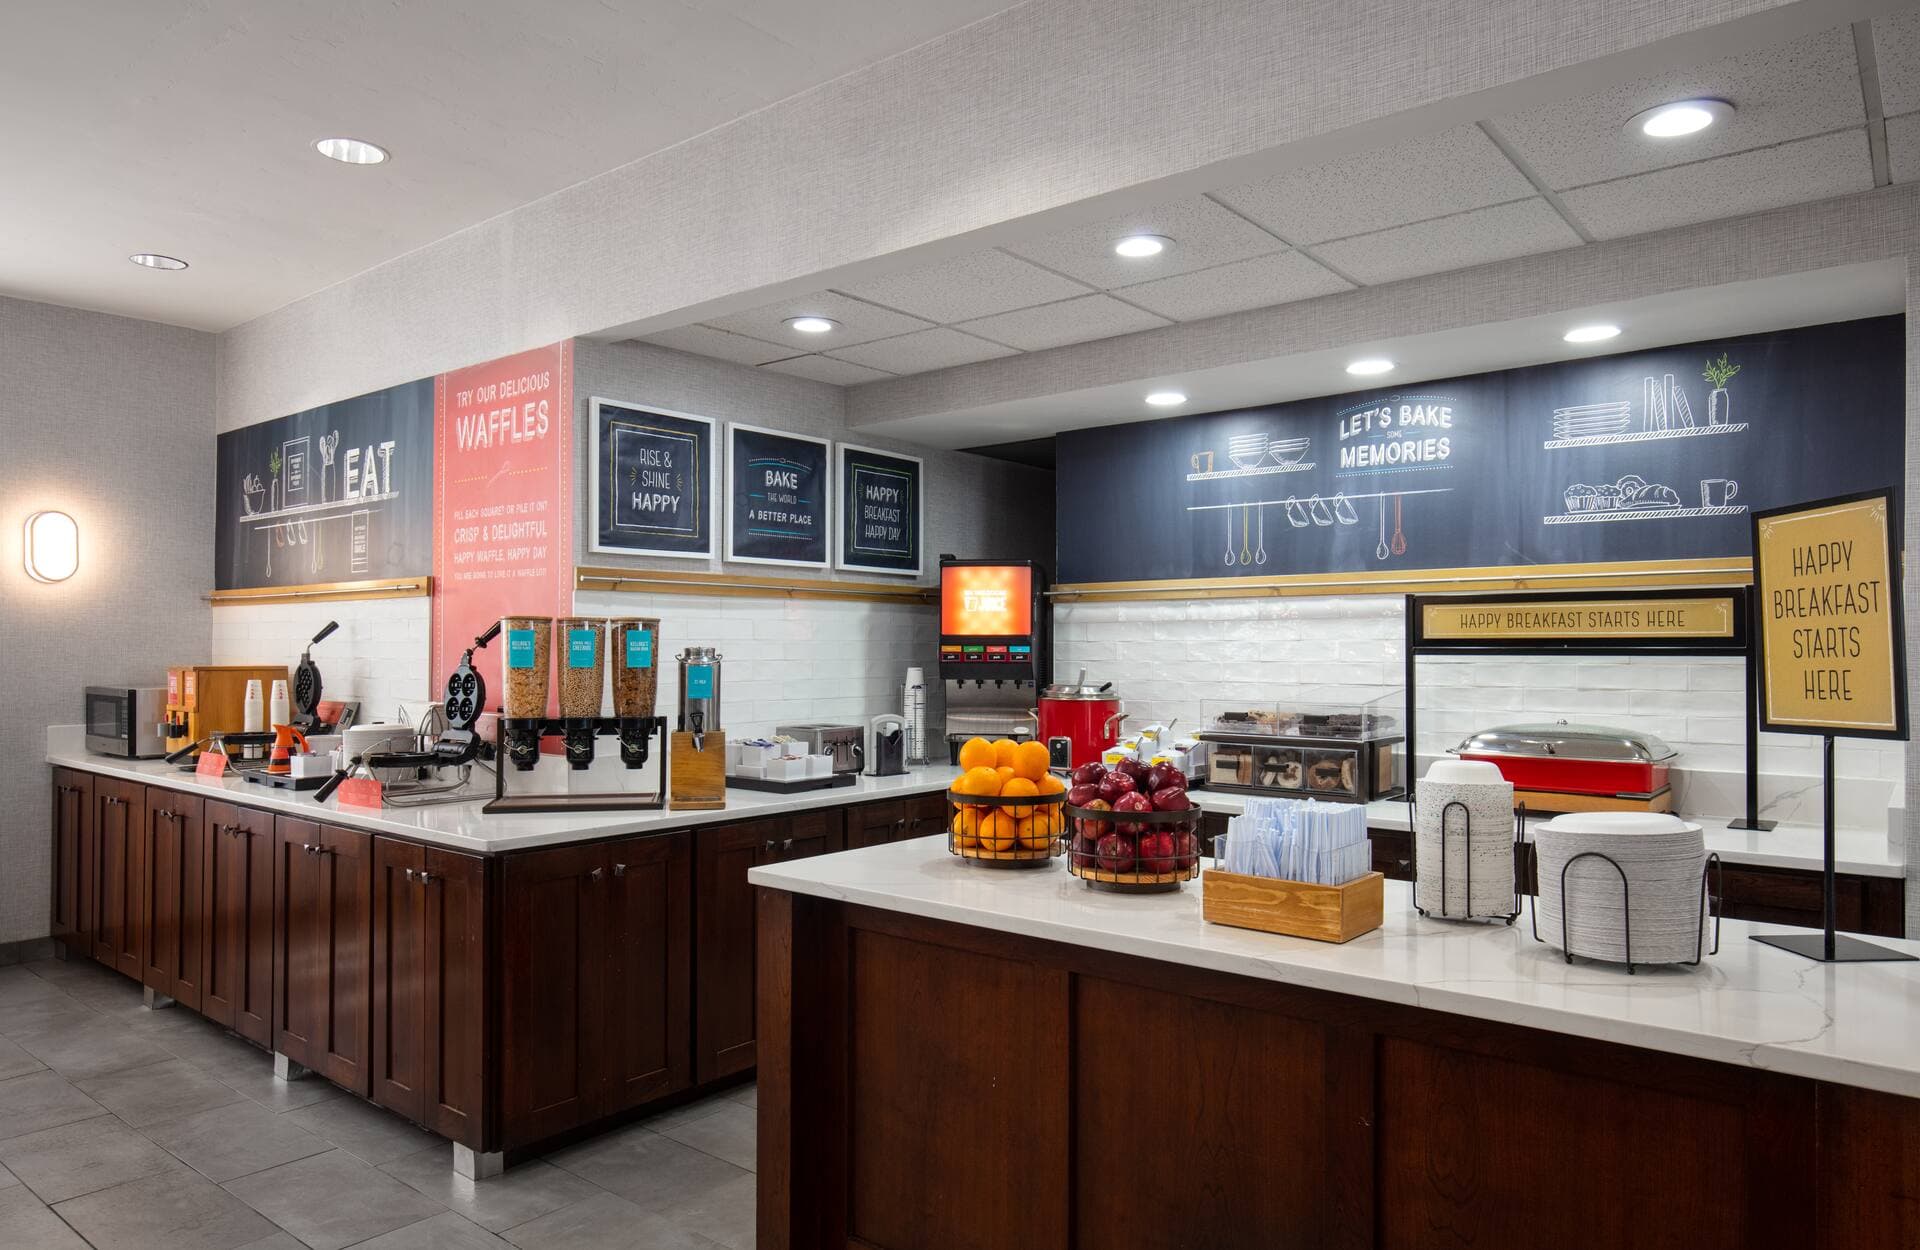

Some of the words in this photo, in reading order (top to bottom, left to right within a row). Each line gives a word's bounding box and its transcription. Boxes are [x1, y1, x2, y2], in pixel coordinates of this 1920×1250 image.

[456, 389, 474, 408] TRY
[477, 384, 497, 403] OUR
[500, 371, 550, 399] DELICIOUS
[456, 400, 549, 451] WAFFLES
[1339, 406, 1392, 440] LET'S
[1399, 404, 1453, 428] BAKE
[640, 448, 661, 466] RISE
[663, 451, 673, 468] &
[1340, 437, 1451, 469] MEMORIES
[344, 441, 396, 500] EAT
[641, 470, 671, 489] SHINE
[765, 469, 798, 489] BAKE
[632, 491, 680, 514] HAPPY
[866, 484, 900, 503] HAPPY
[748, 509, 755, 519] A
[757, 510, 787, 522] BETTER
[789, 513, 812, 525] PLACE
[864, 504, 901, 523] BREAKFAST
[454, 526, 479, 544] CRISP
[482, 526, 488, 541] &
[492, 520, 548, 541] DELIGHTFUL
[864, 524, 888, 540] HAPPY
[888, 526, 901, 541] DAY
[507, 546, 531, 560] HAPPY
[532, 545, 548, 560] DAY
[1792, 540, 1853, 577] HAPPY
[1773, 581, 1880, 619] BREAKFAST
[1460, 613, 1501, 629] HAPPY
[1507, 611, 1582, 629] BREAKFAST
[1588, 610, 1640, 628] STARTS
[1647, 609, 1686, 627] HERE
[1793, 626, 1860, 658] STARTS
[1804, 669, 1853, 701] HERE
